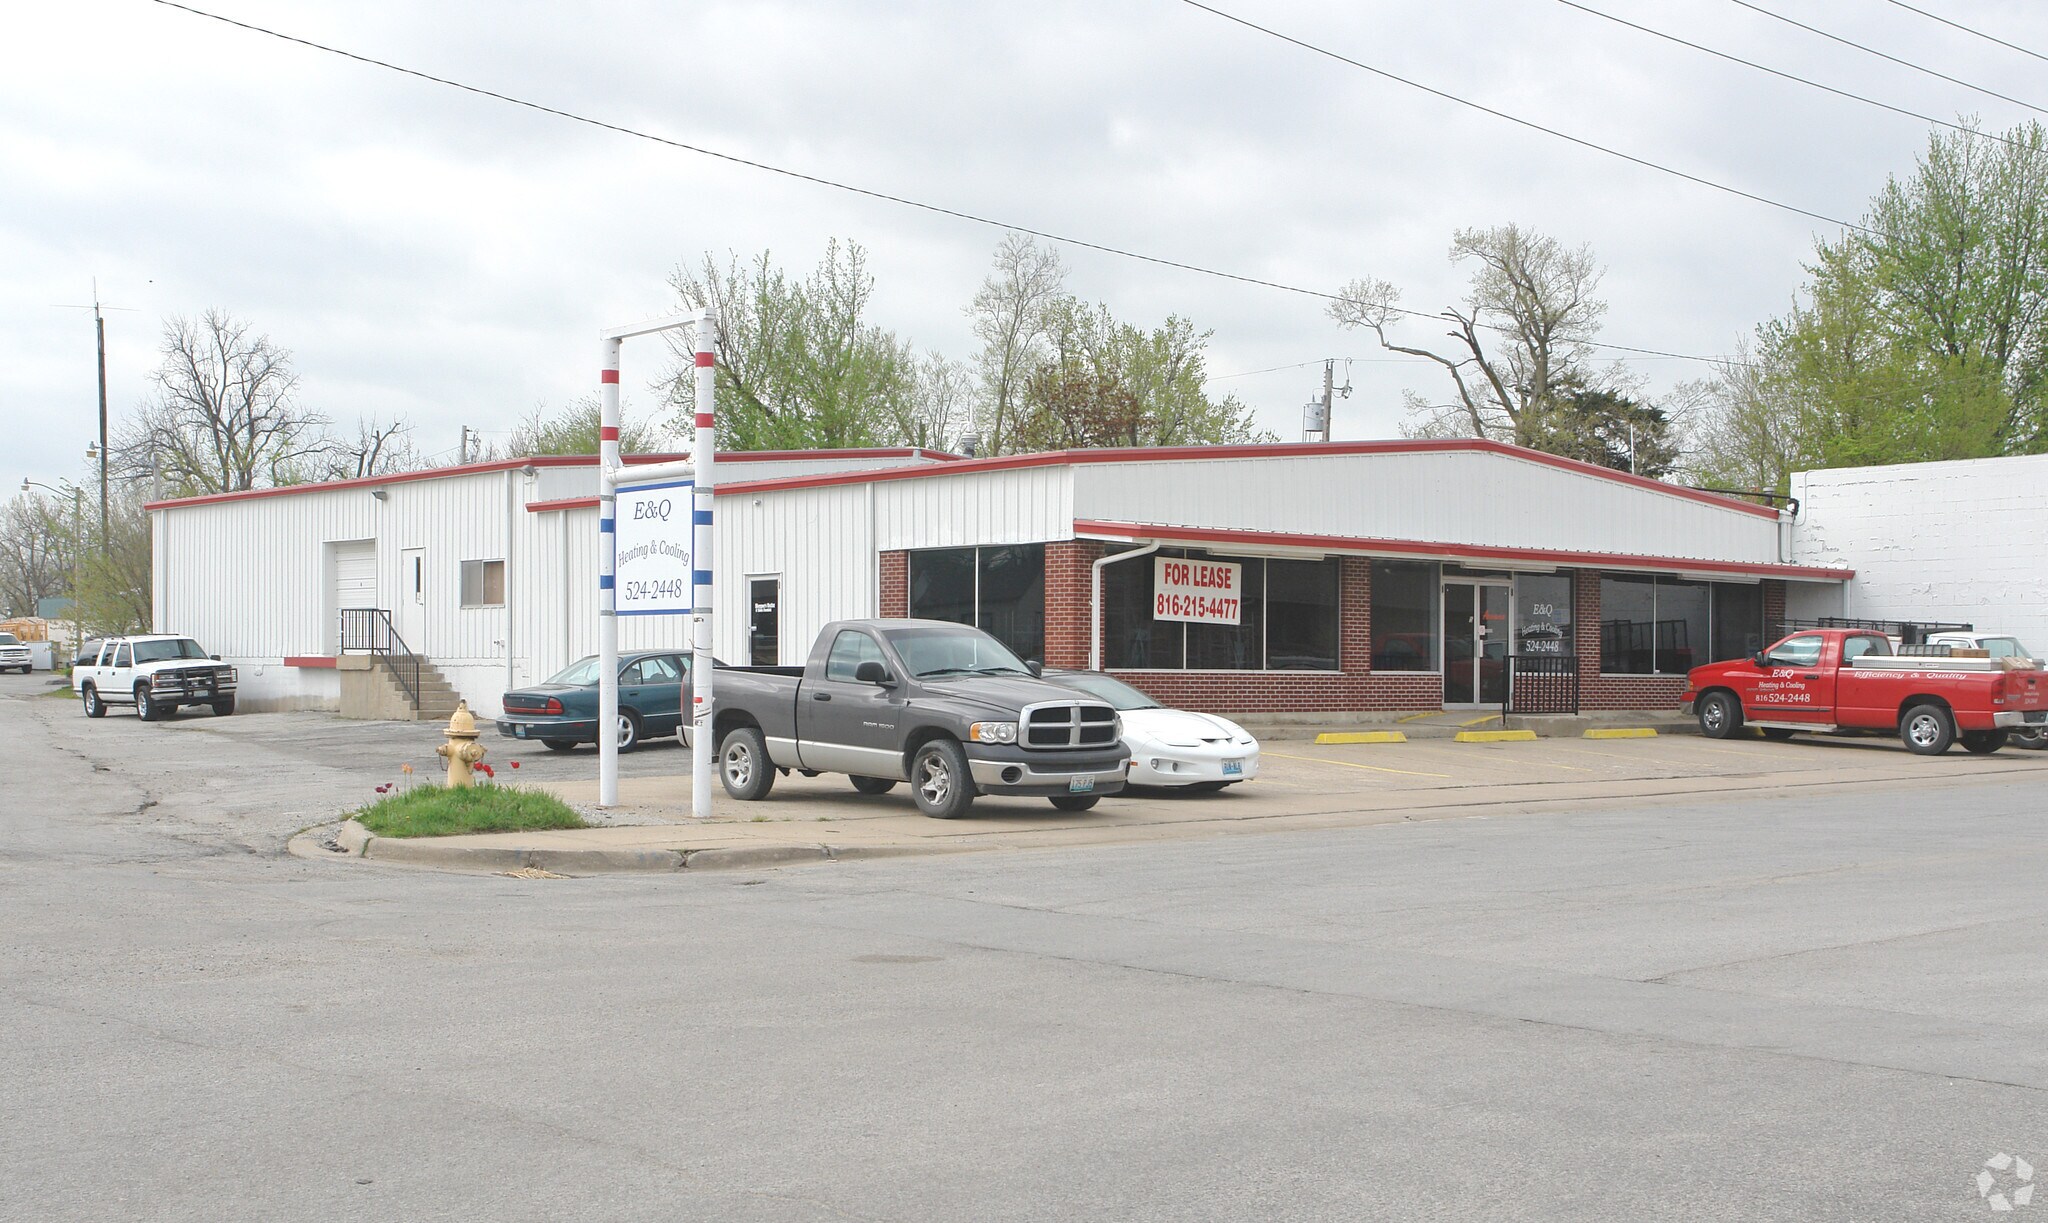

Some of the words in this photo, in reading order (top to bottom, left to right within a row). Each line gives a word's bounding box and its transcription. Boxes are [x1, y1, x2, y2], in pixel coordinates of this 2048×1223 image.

[633, 499, 672, 522] E&Q
[618, 543, 649, 568] Heating
[650, 540, 657, 555] &
[659, 540, 690, 567] Cooling
[1164, 563, 1189, 586] FOR
[1193, 565, 1232, 589] LEASE
[625, 578, 682, 601] 524-2448
[1157, 593, 1238, 620] 816-215-4477
[1533, 603, 1553, 617] E&Q
[1525, 640, 1560, 652] 524-2448
[1771, 669, 1794, 679] E&Q
[1854, 671, 1904, 680] Efficiency
[1926, 672, 1967, 680] Quality
[1758, 681, 1779, 690] Heating
[1785, 681, 1806, 690] Cooling
[1755, 694, 1768, 702] 816
[1768, 693, 1811, 703] 524-2448
